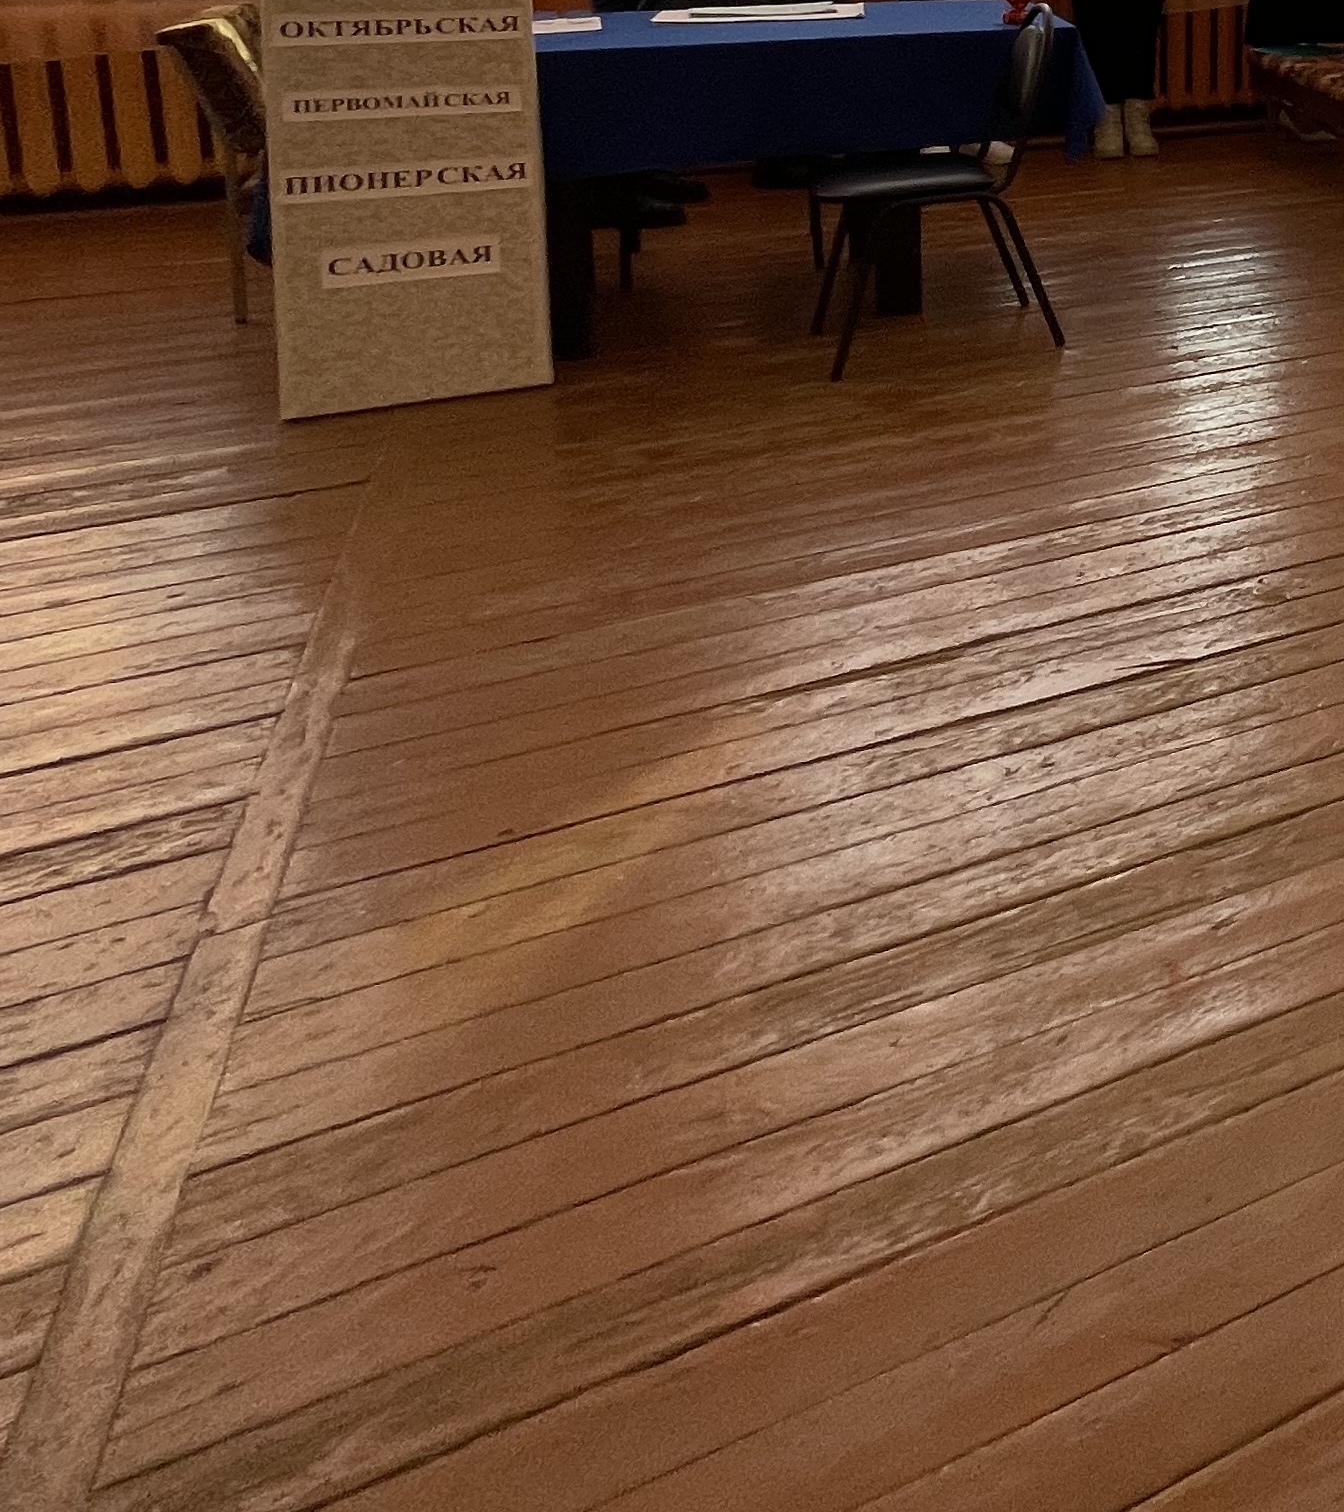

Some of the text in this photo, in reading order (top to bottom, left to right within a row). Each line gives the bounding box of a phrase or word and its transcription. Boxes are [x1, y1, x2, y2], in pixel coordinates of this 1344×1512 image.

[280, 15, 520, 38] ОКТЯБРЬСКАЯ
[293, 90, 511, 114] ПЕРВОМАЙСКАЯ
[284, 161, 528, 196] ПИОНЕРСКАЯ
[327, 244, 493, 277] САДОВАЯ
